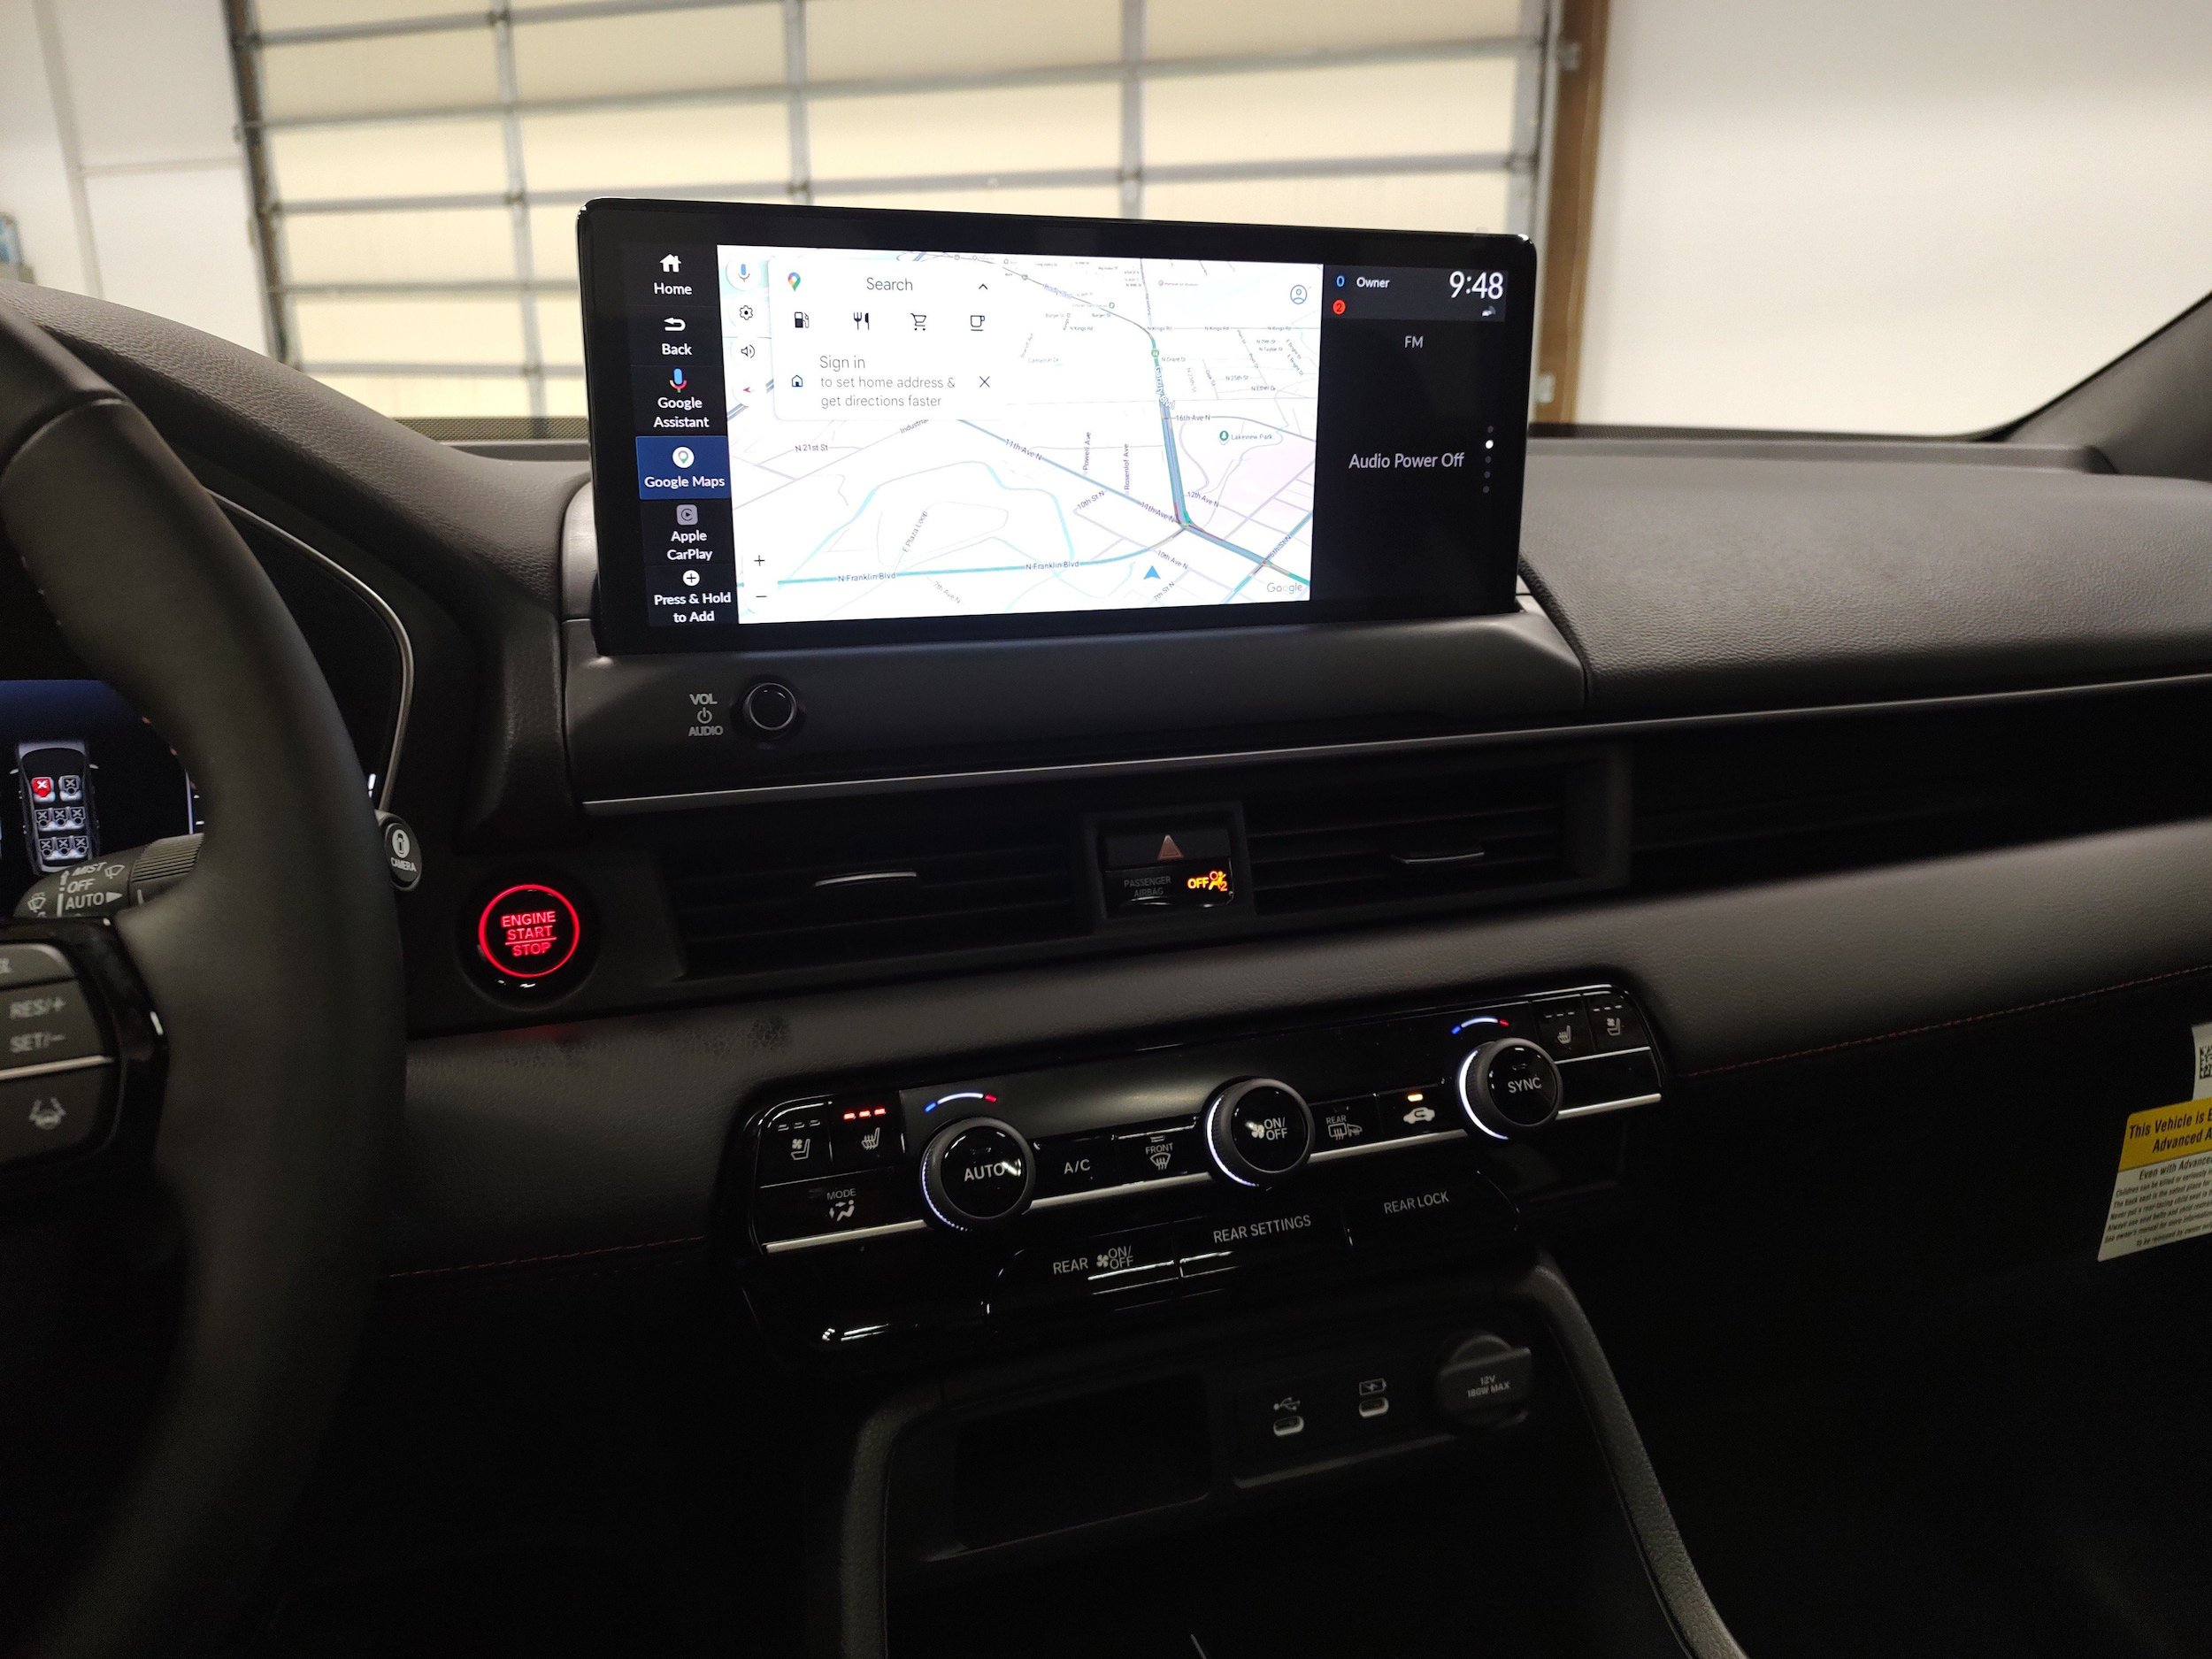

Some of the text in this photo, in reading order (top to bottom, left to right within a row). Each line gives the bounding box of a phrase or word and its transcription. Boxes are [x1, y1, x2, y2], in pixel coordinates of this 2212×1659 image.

[654, 282, 692, 296] Home
[866, 277, 913, 291] Search
[1356, 276, 1390, 288] Owner
[1449, 271, 1504, 300] 9:48
[1404, 335, 1424, 349] FM
[662, 343, 692, 356] Back
[819, 356, 865, 373] Sign in
[821, 377, 956, 388] to set home address &
[657, 396, 703, 411] Google
[821, 396, 942, 409] get directions faster
[653, 417, 710, 428] Assistant
[803, 443, 819, 452] 21st
[1021, 445, 1035, 457] Ave
[1035, 452, 1042, 461] N
[1348, 452, 1465, 469] Audio Power Off
[644, 476, 726, 489] Google Maps
[1077, 498, 1092, 511] 10th
[1187, 491, 1201, 501] 12th
[1201, 495, 1214, 505] Ave
[914, 510, 928, 529] Loop
[671, 529, 707, 543] Apple
[666, 549, 712, 561] CarPlay
[1157, 549, 1171, 562] 10th
[1171, 557, 1183, 567] Ave
[1269, 545, 1280, 558] 6th
[1033, 561, 1063, 570] Franklin
[1266, 582, 1302, 594] Google
[654, 592, 732, 605] Press & Hold
[673, 611, 715, 623] to Add
[689, 693, 718, 705] VOL
[688, 726, 724, 736] AUDIO
[72, 862, 108, 877] MIST
[390, 857, 417, 872] CAMERA
[67, 879, 96, 894] OFF
[1124, 876, 1171, 887] PASSENGER
[1187, 877, 1210, 889] OFF
[1133, 887, 1164, 897] AIRBAG
[65, 893, 104, 910] AUTO
[501, 910, 557, 928] ENGINE
[506, 926, 553, 941] START
[511, 942, 552, 957] STOP
[1508, 1076, 1542, 1094] SYNC
[1263, 1117, 1286, 1130] ON/
[1326, 1114, 1348, 1124] REAR
[2130, 1110, 2204, 1140] This Vehicle is
[1265, 1126, 1287, 1141] OFF
[2152, 1128, 2203, 1153] Advanced
[1145, 1142, 1174, 1155] FRONT
[964, 1161, 1005, 1183] AUTO
[1064, 1159, 1091, 1175] A/C
[826, 1187, 856, 1202] MODE
[1384, 1190, 1450, 1217] REAR LOCK
[1213, 1214, 1312, 1244] REAR SETTINGS
[1053, 1245, 1132, 1275] REAR ON/
[1109, 1255, 1133, 1271] OFF
[1479, 1374, 1496, 1386] 12V
[1490, 1380, 1511, 1394] MAX
